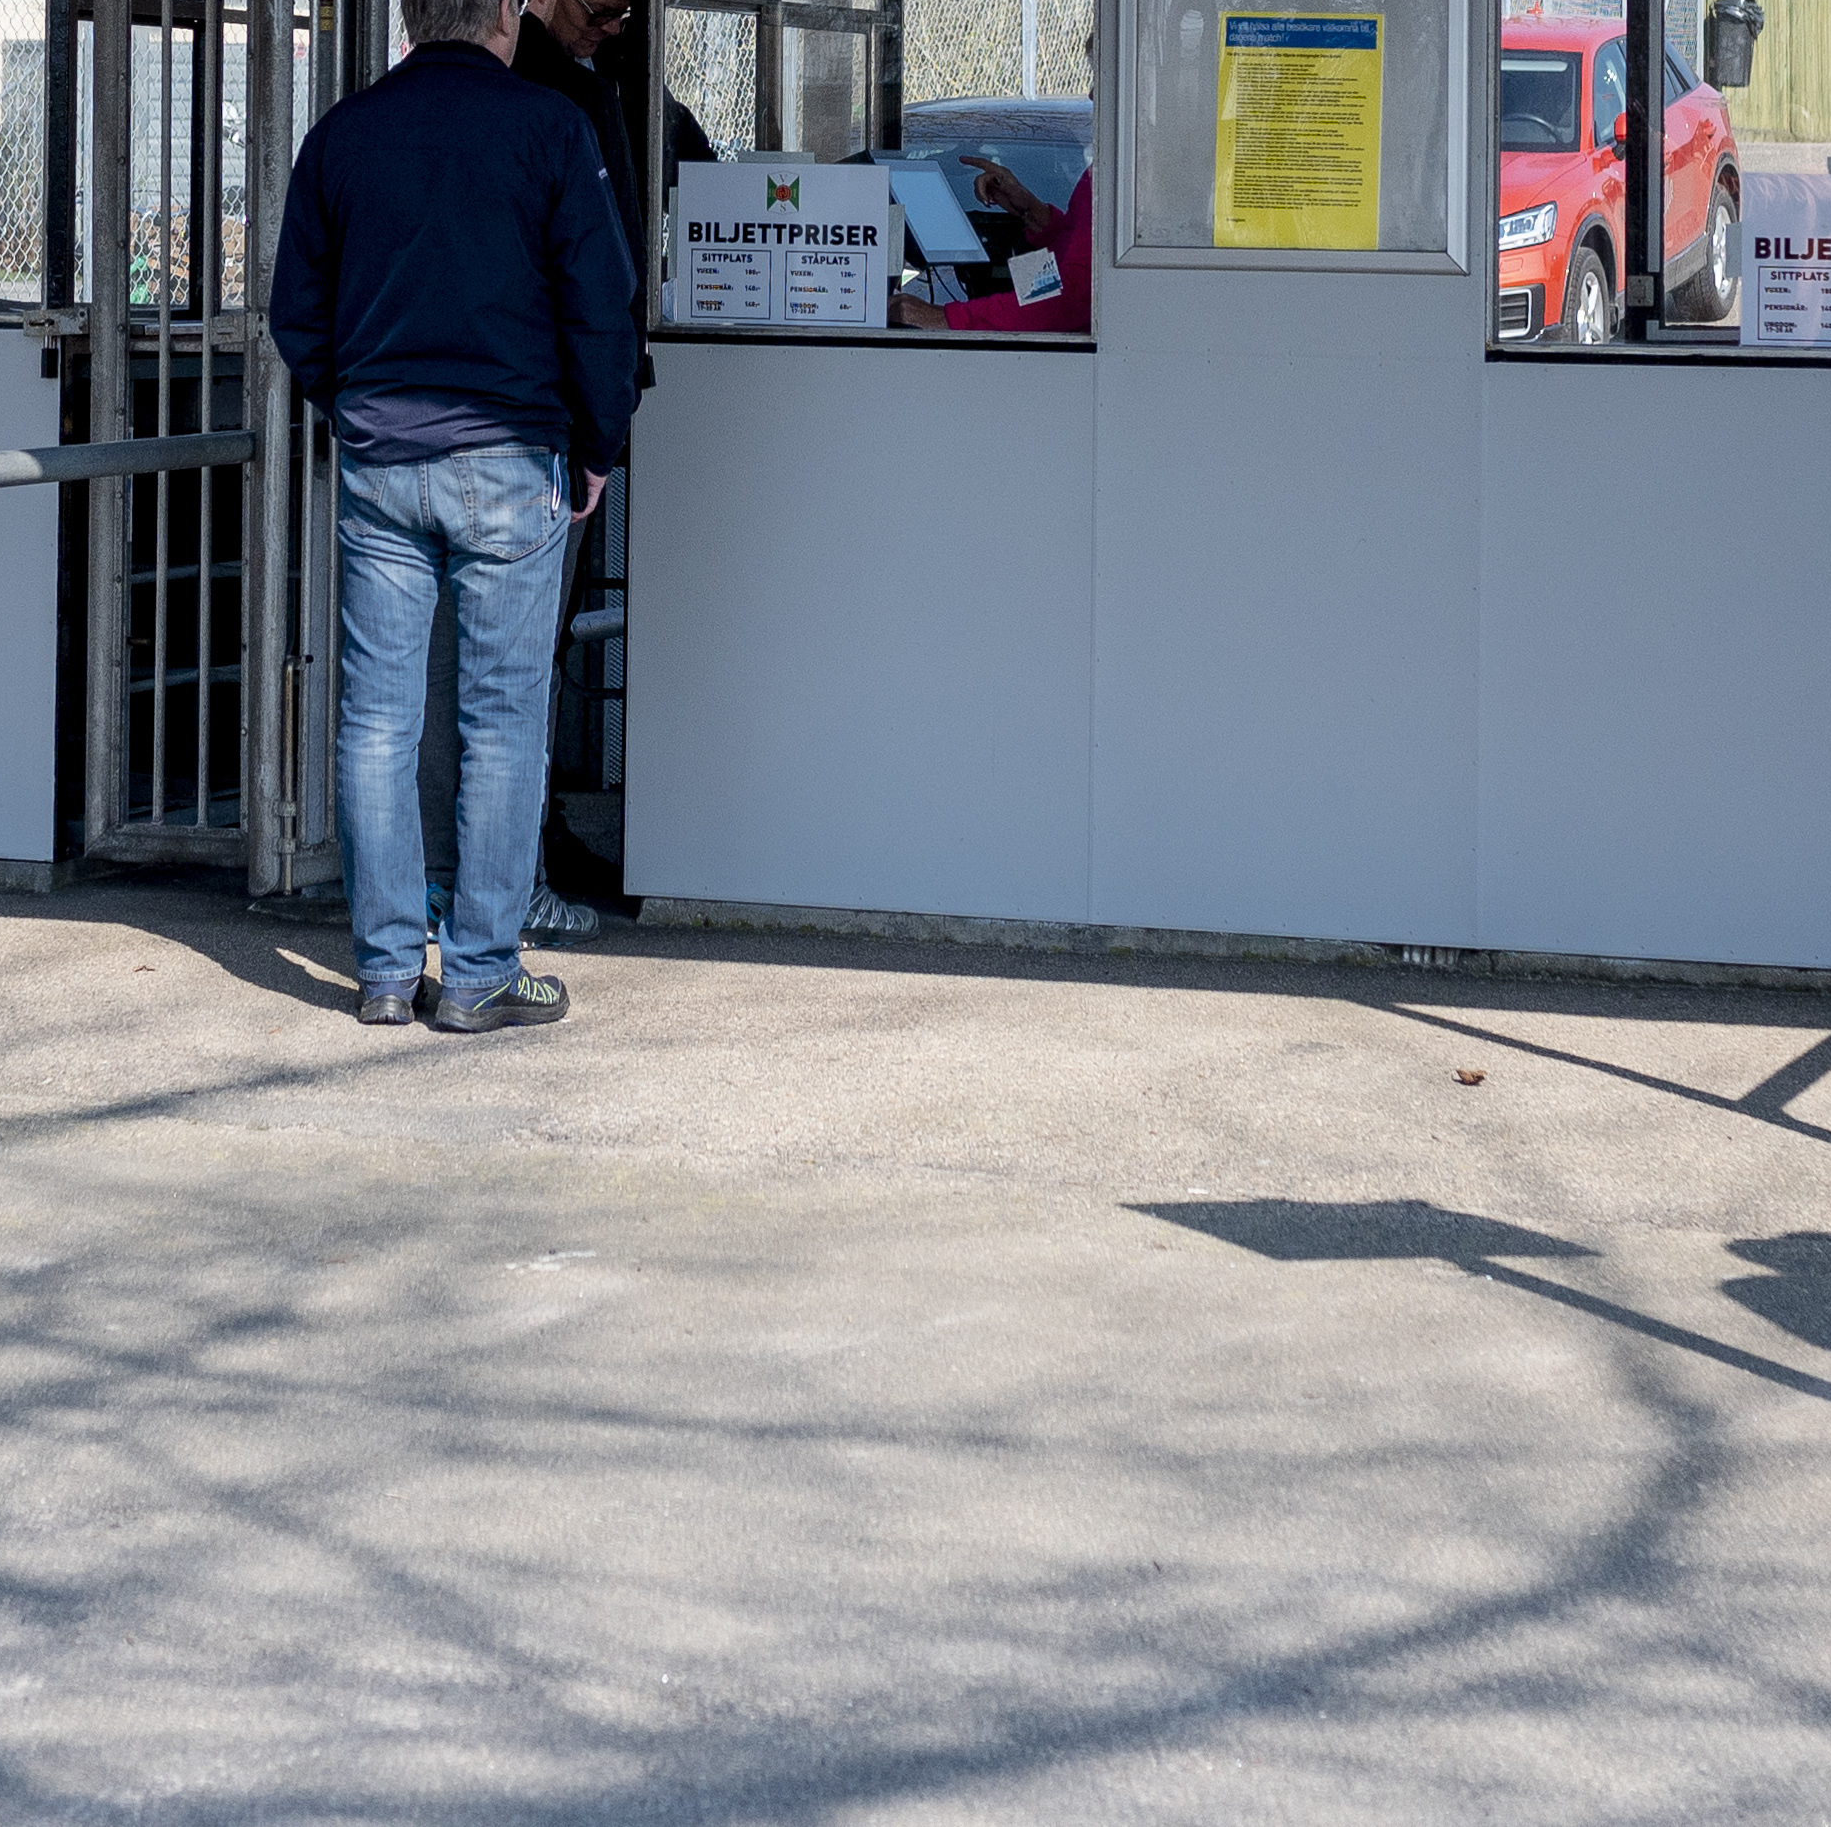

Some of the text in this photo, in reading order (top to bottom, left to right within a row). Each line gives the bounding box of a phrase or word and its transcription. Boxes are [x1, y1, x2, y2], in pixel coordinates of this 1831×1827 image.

[688, 222, 878, 246] BILJETTPRISER
[702, 253, 753, 263] SITTPLATS
[801, 253, 850, 265] STÅPLATS
[1770, 271, 1830, 281] SITTPLATS
